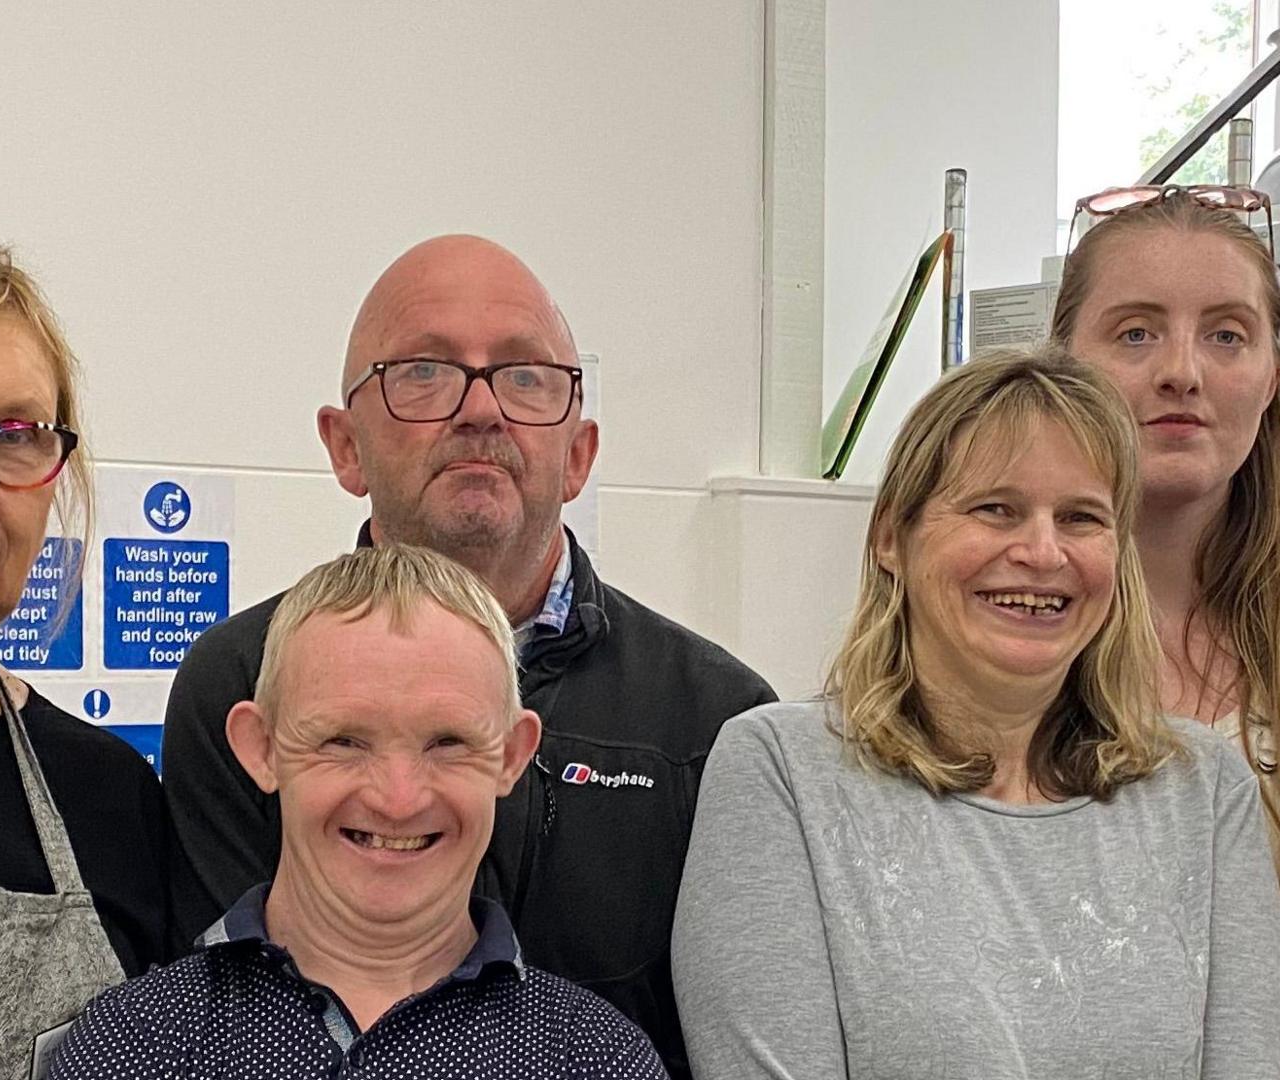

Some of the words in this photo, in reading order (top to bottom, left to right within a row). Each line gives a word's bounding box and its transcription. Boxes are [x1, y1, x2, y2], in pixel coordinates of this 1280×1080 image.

[125, 546, 168, 563] Wash
[173, 551, 208, 566] your
[28, 565, 63, 579] tion
[116, 566, 163, 583] hands
[169, 567, 218, 583] before
[133, 588, 161, 602] and
[167, 588, 201, 602] after
[11, 607, 47, 624] kept
[117, 607, 185, 626] handling
[189, 611, 217, 623] raw
[122, 628, 150, 642] and
[155, 628, 200, 643] cooke
[19, 646, 50, 665] tidy
[150, 647, 185, 663] food
[590, 770, 655, 789] berghaus
